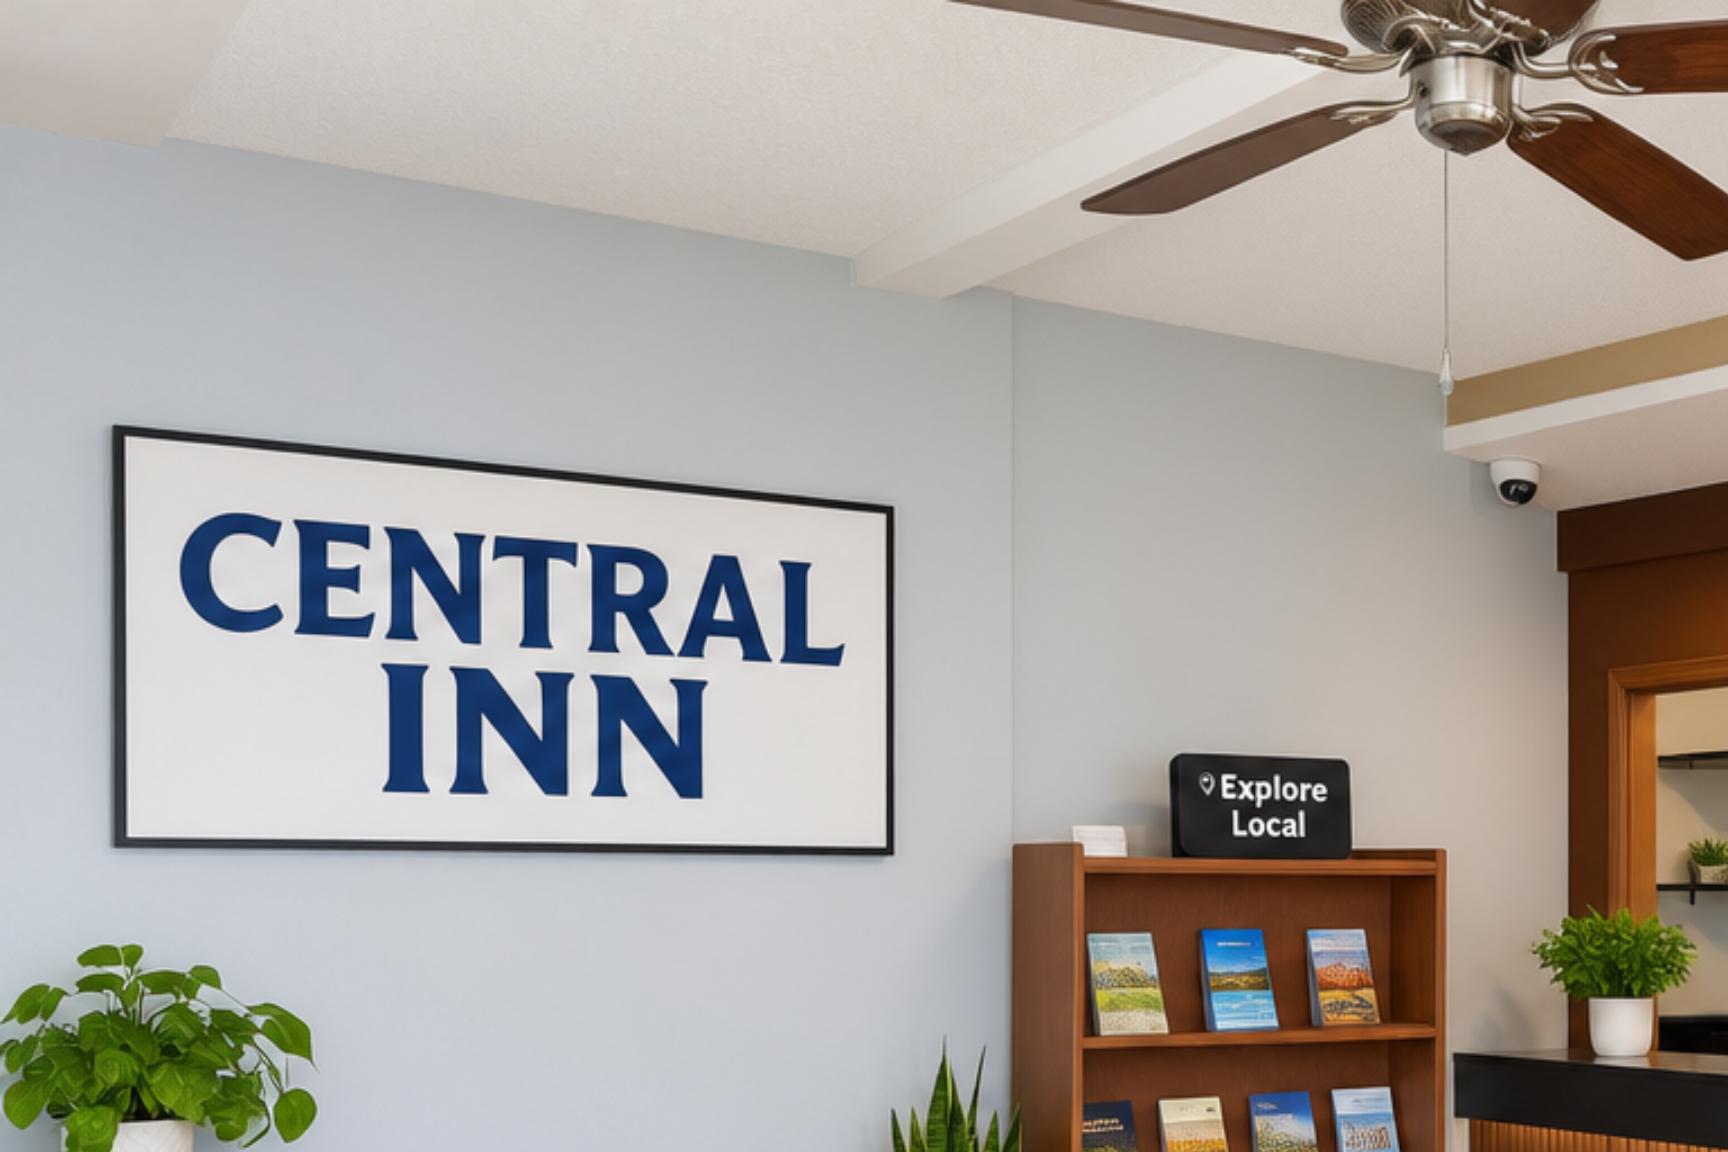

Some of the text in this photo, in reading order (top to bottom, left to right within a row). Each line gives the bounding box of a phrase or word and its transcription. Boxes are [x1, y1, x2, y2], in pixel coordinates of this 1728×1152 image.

[179, 512, 845, 666] CENTRAL
[381, 662, 709, 799] INN
[1220, 774, 1328, 807] Explore
[1232, 810, 1306, 838] Local
